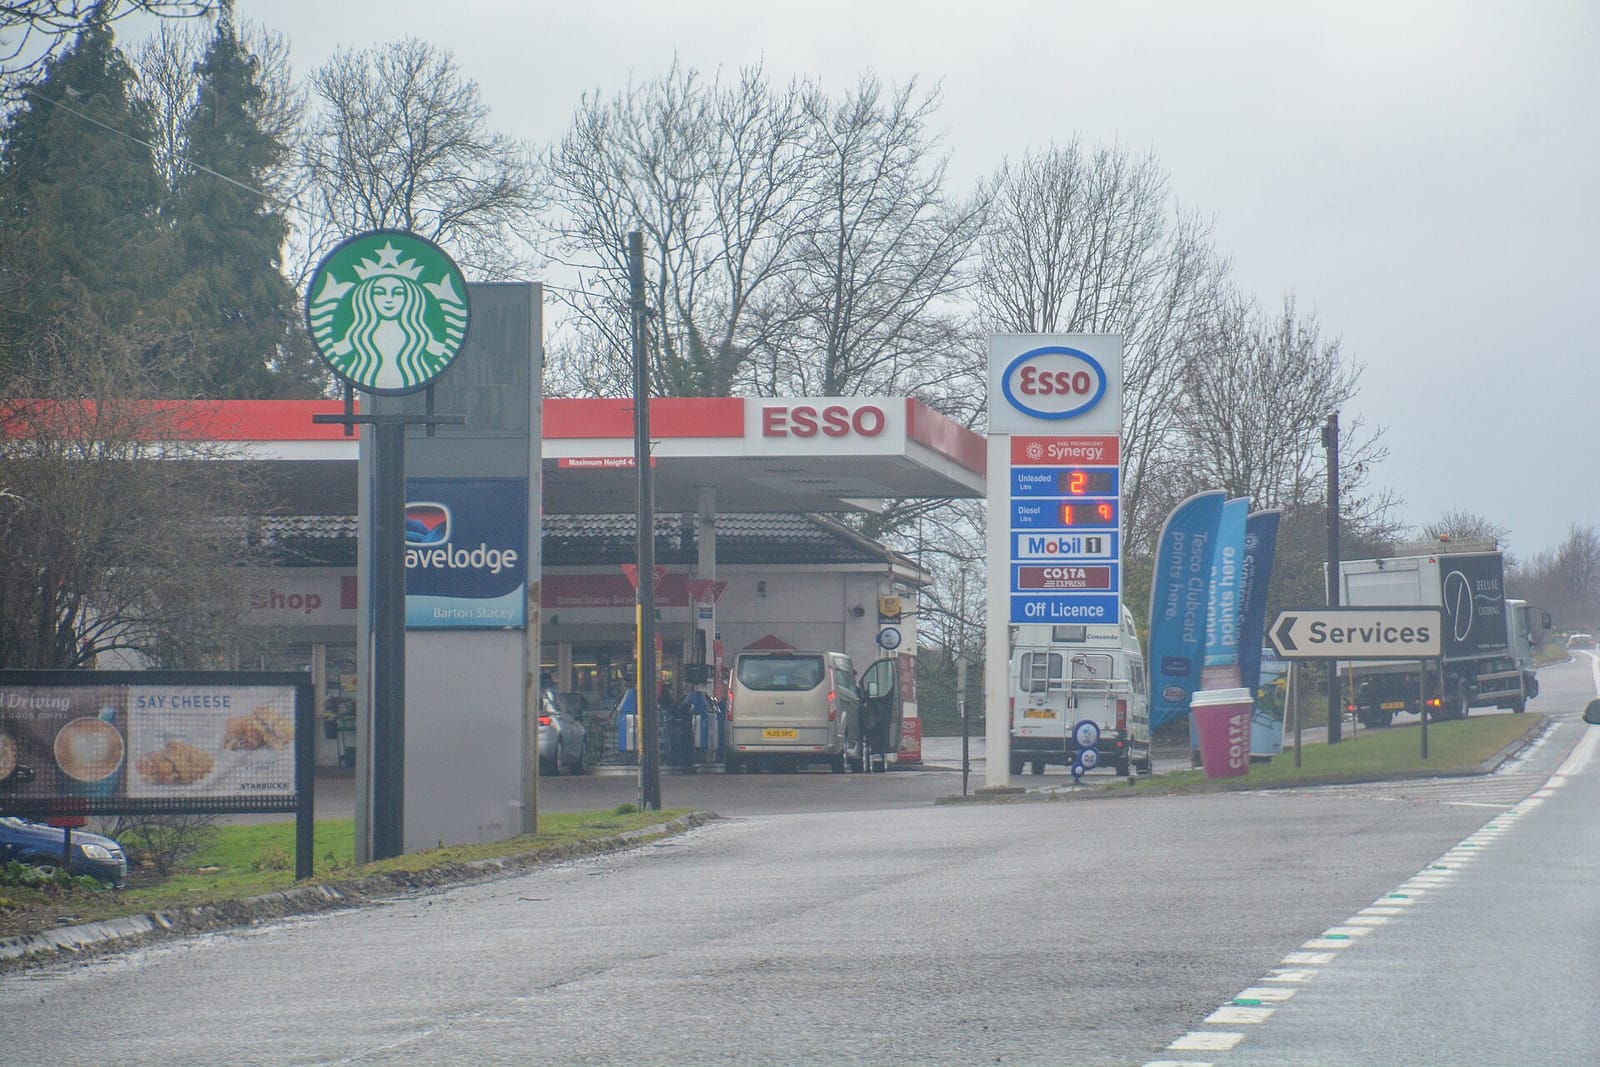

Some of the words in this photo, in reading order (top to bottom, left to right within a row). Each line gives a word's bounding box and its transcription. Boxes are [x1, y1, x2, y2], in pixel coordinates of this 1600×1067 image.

[763, 406, 885, 437] ESSO
[1048, 444, 1103, 460] Synergy
[604, 459, 627, 467] Height
[1018, 474, 1051, 482] Unleaded
[1070, 472, 1084, 493] 2
[1018, 506, 1040, 514] Diesel
[1029, 537, 1081, 554] Mobil
[1170, 531, 1184, 578] points
[1190, 532, 1208, 572] Tesco
[405, 543, 517, 573] avelodge
[1219, 546, 1235, 586] here
[1043, 568, 1086, 579] COSTA
[433, 607, 473, 618] Barton
[477, 607, 514, 620] Stacey
[1025, 602, 1046, 617] Off
[1051, 602, 1104, 617] Licence
[1183, 577, 1203, 642] Clubcard
[1219, 591, 1235, 646] points
[1308, 622, 1430, 644] Services
[8, 693, 71, 711] Driving
[137, 696, 166, 708] SAY
[171, 696, 231, 708] CHEESE
